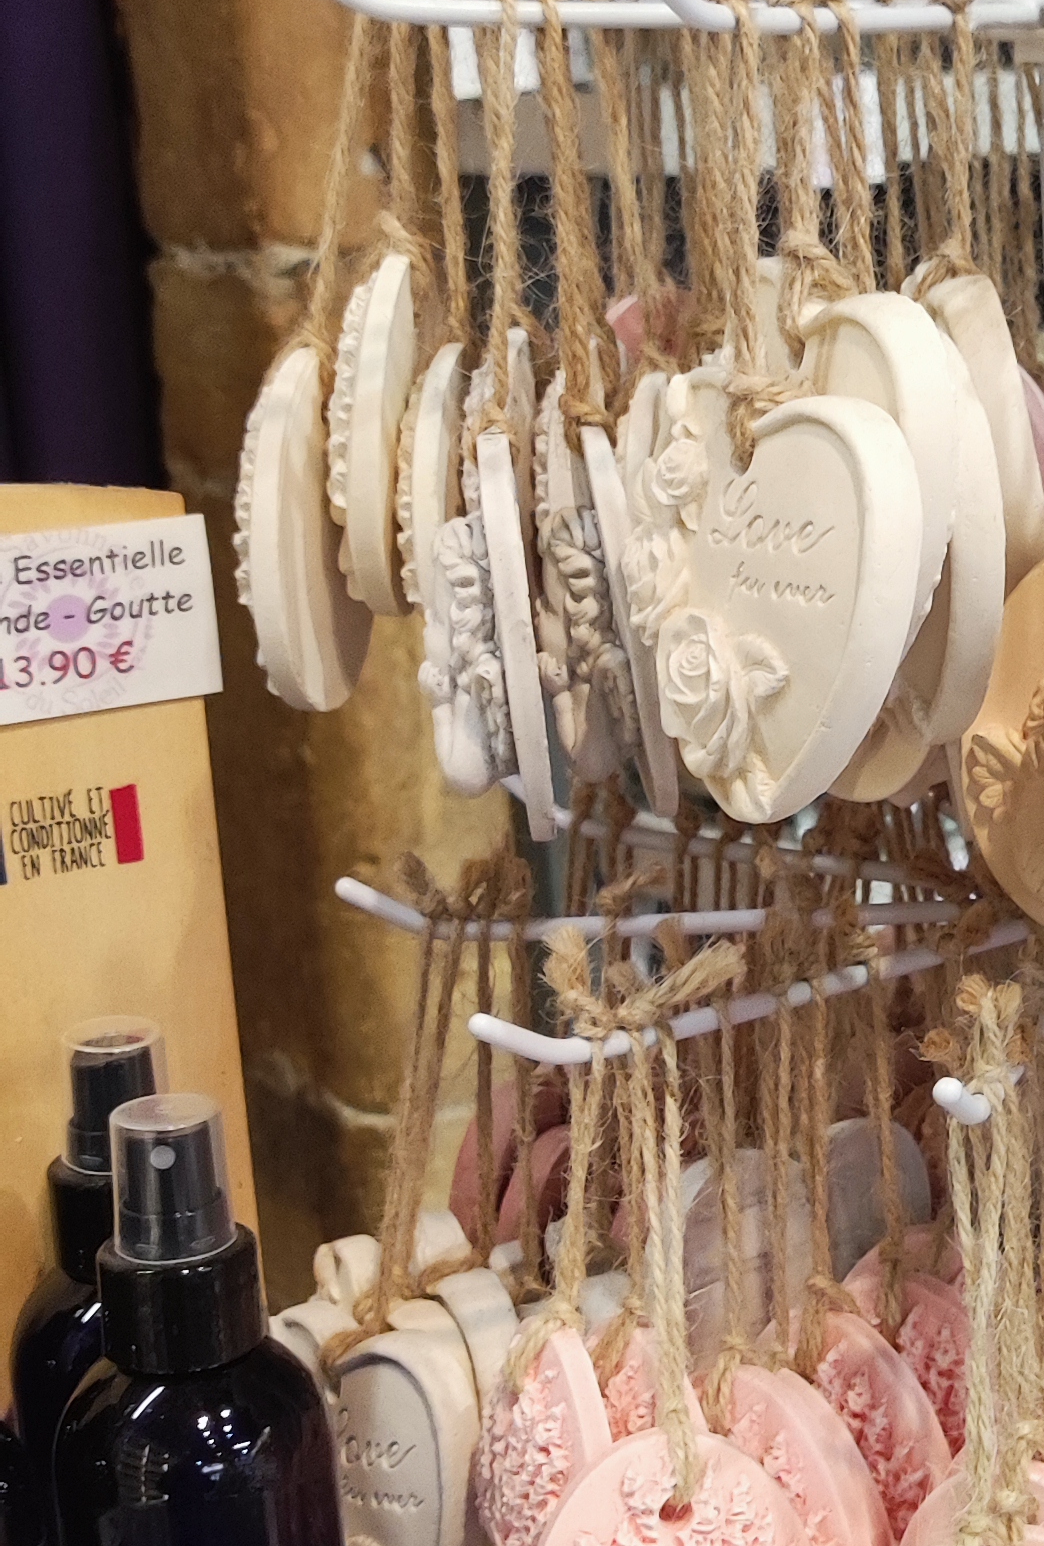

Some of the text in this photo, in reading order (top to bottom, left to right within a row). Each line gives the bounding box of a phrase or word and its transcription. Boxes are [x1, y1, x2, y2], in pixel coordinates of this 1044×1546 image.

[13, 539, 186, 585] Essentielle
[0, 604, 51, 635] nde
[87, 591, 193, 624] Goutte
[109, 640, 135, 674] €
[87, 787, 104, 814] ET
[21, 842, 106, 880] EN FRANCE
